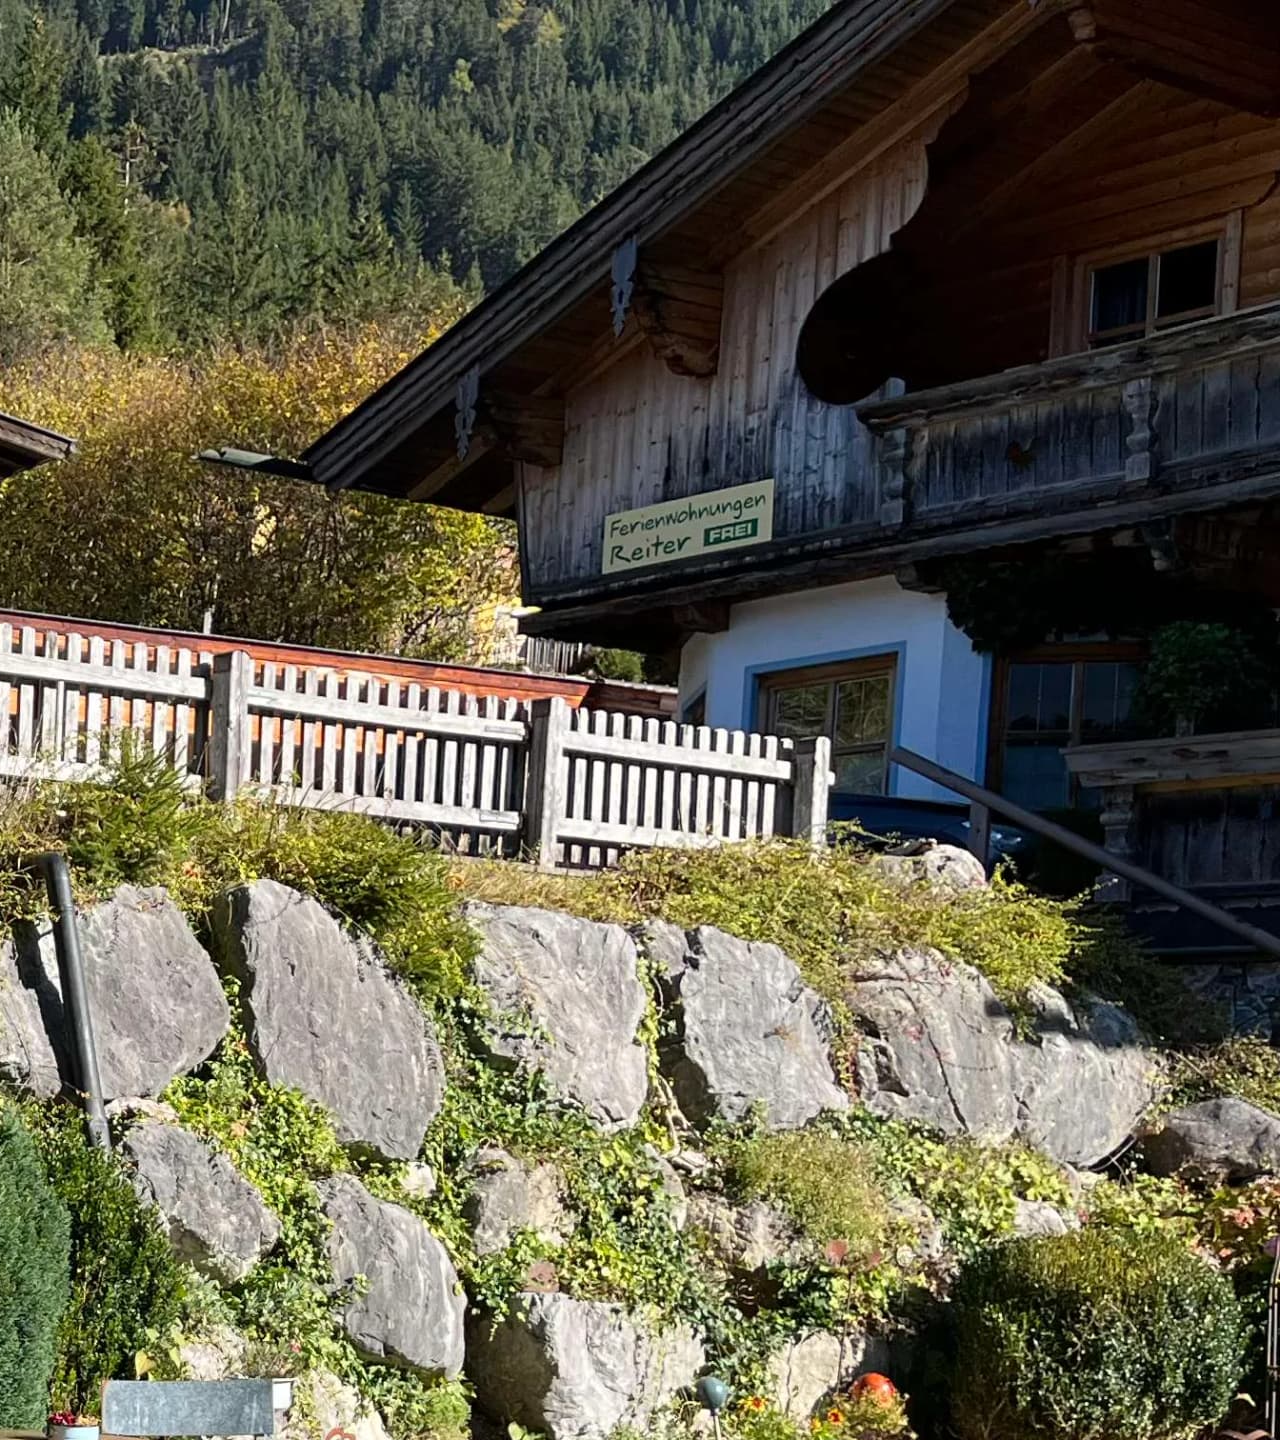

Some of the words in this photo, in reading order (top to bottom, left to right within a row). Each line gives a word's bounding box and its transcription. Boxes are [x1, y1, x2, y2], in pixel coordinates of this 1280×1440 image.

[610, 494, 766, 539] Ferienwohnungen
[708, 522, 753, 544] FREI
[610, 535, 692, 566] Reiter
